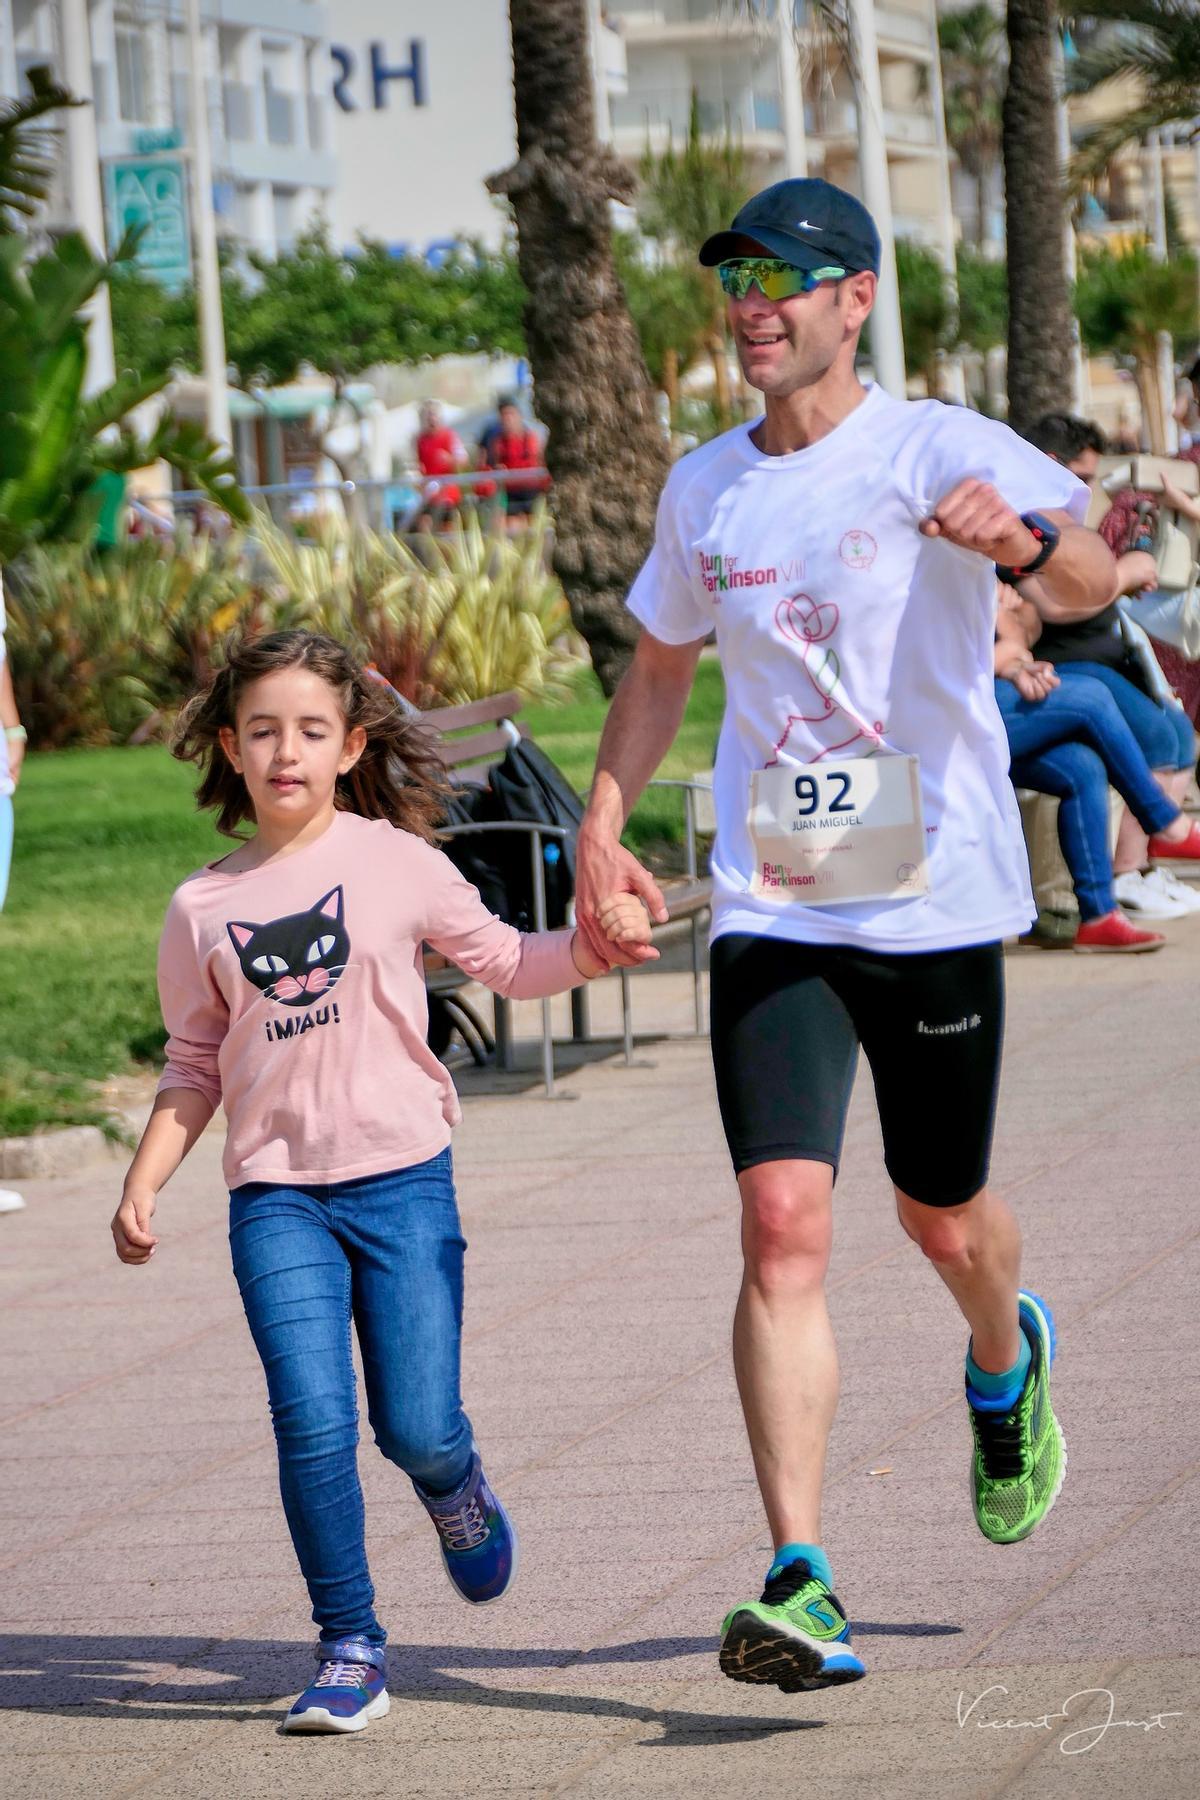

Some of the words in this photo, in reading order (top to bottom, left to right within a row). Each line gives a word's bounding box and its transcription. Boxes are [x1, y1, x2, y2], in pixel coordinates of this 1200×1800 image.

[725, 554, 738, 567] for
[795, 771, 856, 816] 92
[792, 820, 817, 831] JUAN
[819, 815, 863, 828] MIGUEL
[763, 862, 784, 875] Run
[763, 873, 815, 887] Parkinson
